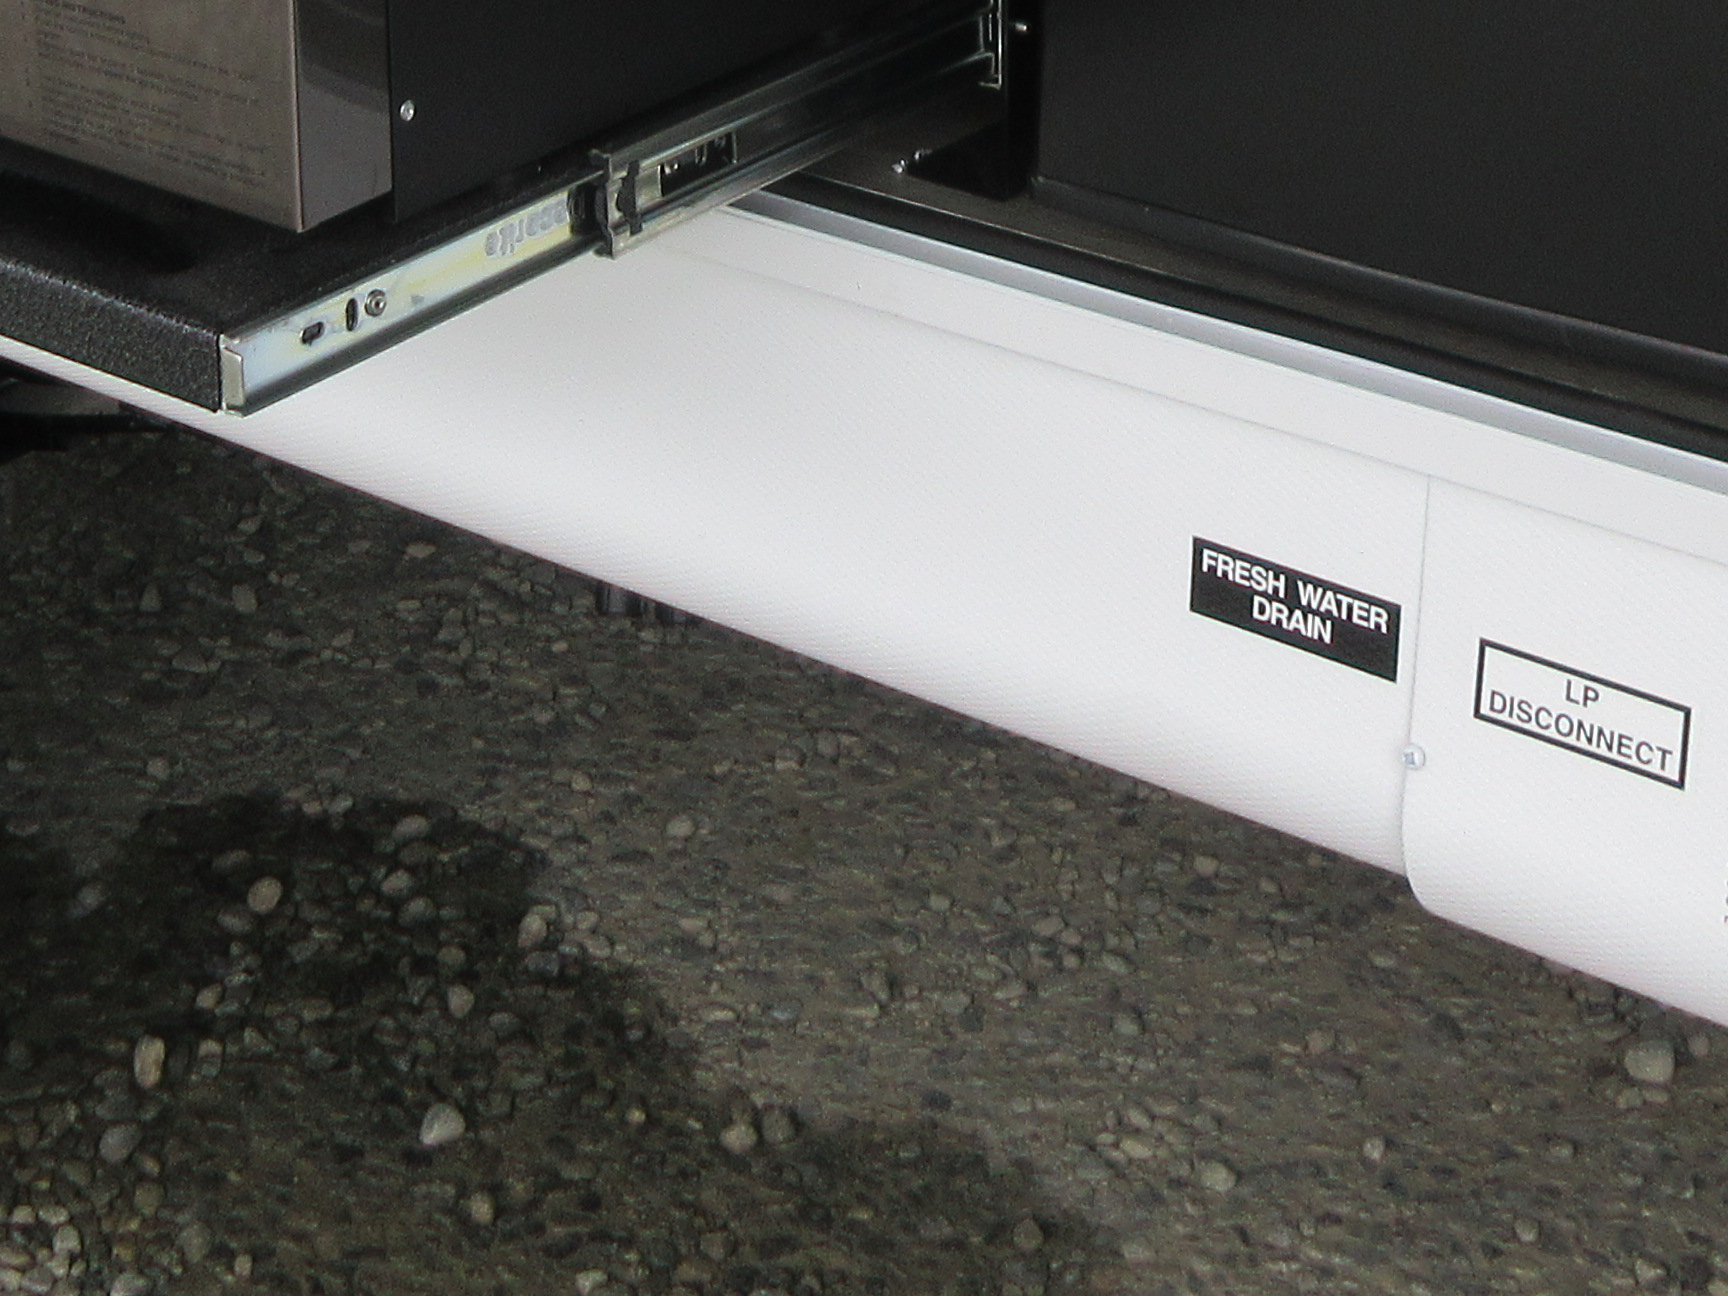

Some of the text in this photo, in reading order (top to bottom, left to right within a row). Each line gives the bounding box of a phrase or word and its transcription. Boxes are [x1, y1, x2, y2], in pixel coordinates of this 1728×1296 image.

[1200, 548, 1389, 634] FRESH WATER
[1251, 595, 1332, 645] DRAIN
[1564, 678, 1600, 708] LP
[1488, 689, 1673, 772] DISCONNECT
